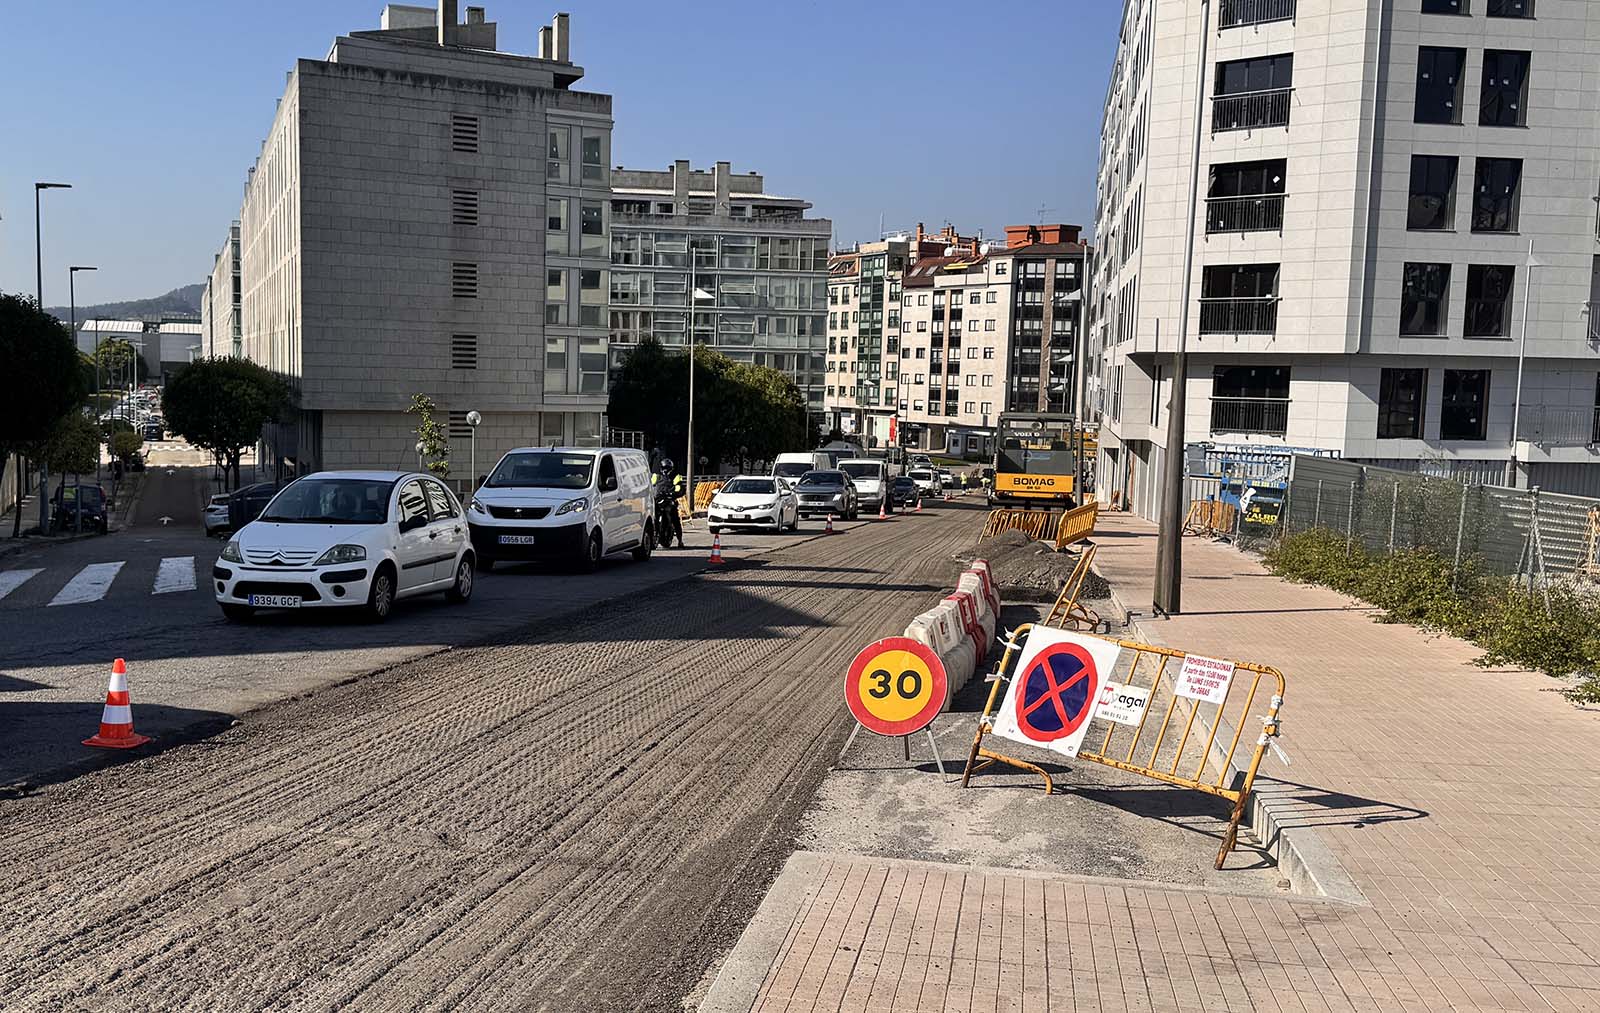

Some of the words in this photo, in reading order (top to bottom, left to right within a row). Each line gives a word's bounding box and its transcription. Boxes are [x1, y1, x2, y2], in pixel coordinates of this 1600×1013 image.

[1013, 478, 1055, 486] BOMAG
[280, 596, 299, 607] GCF
[868, 669, 922, 700] 30
